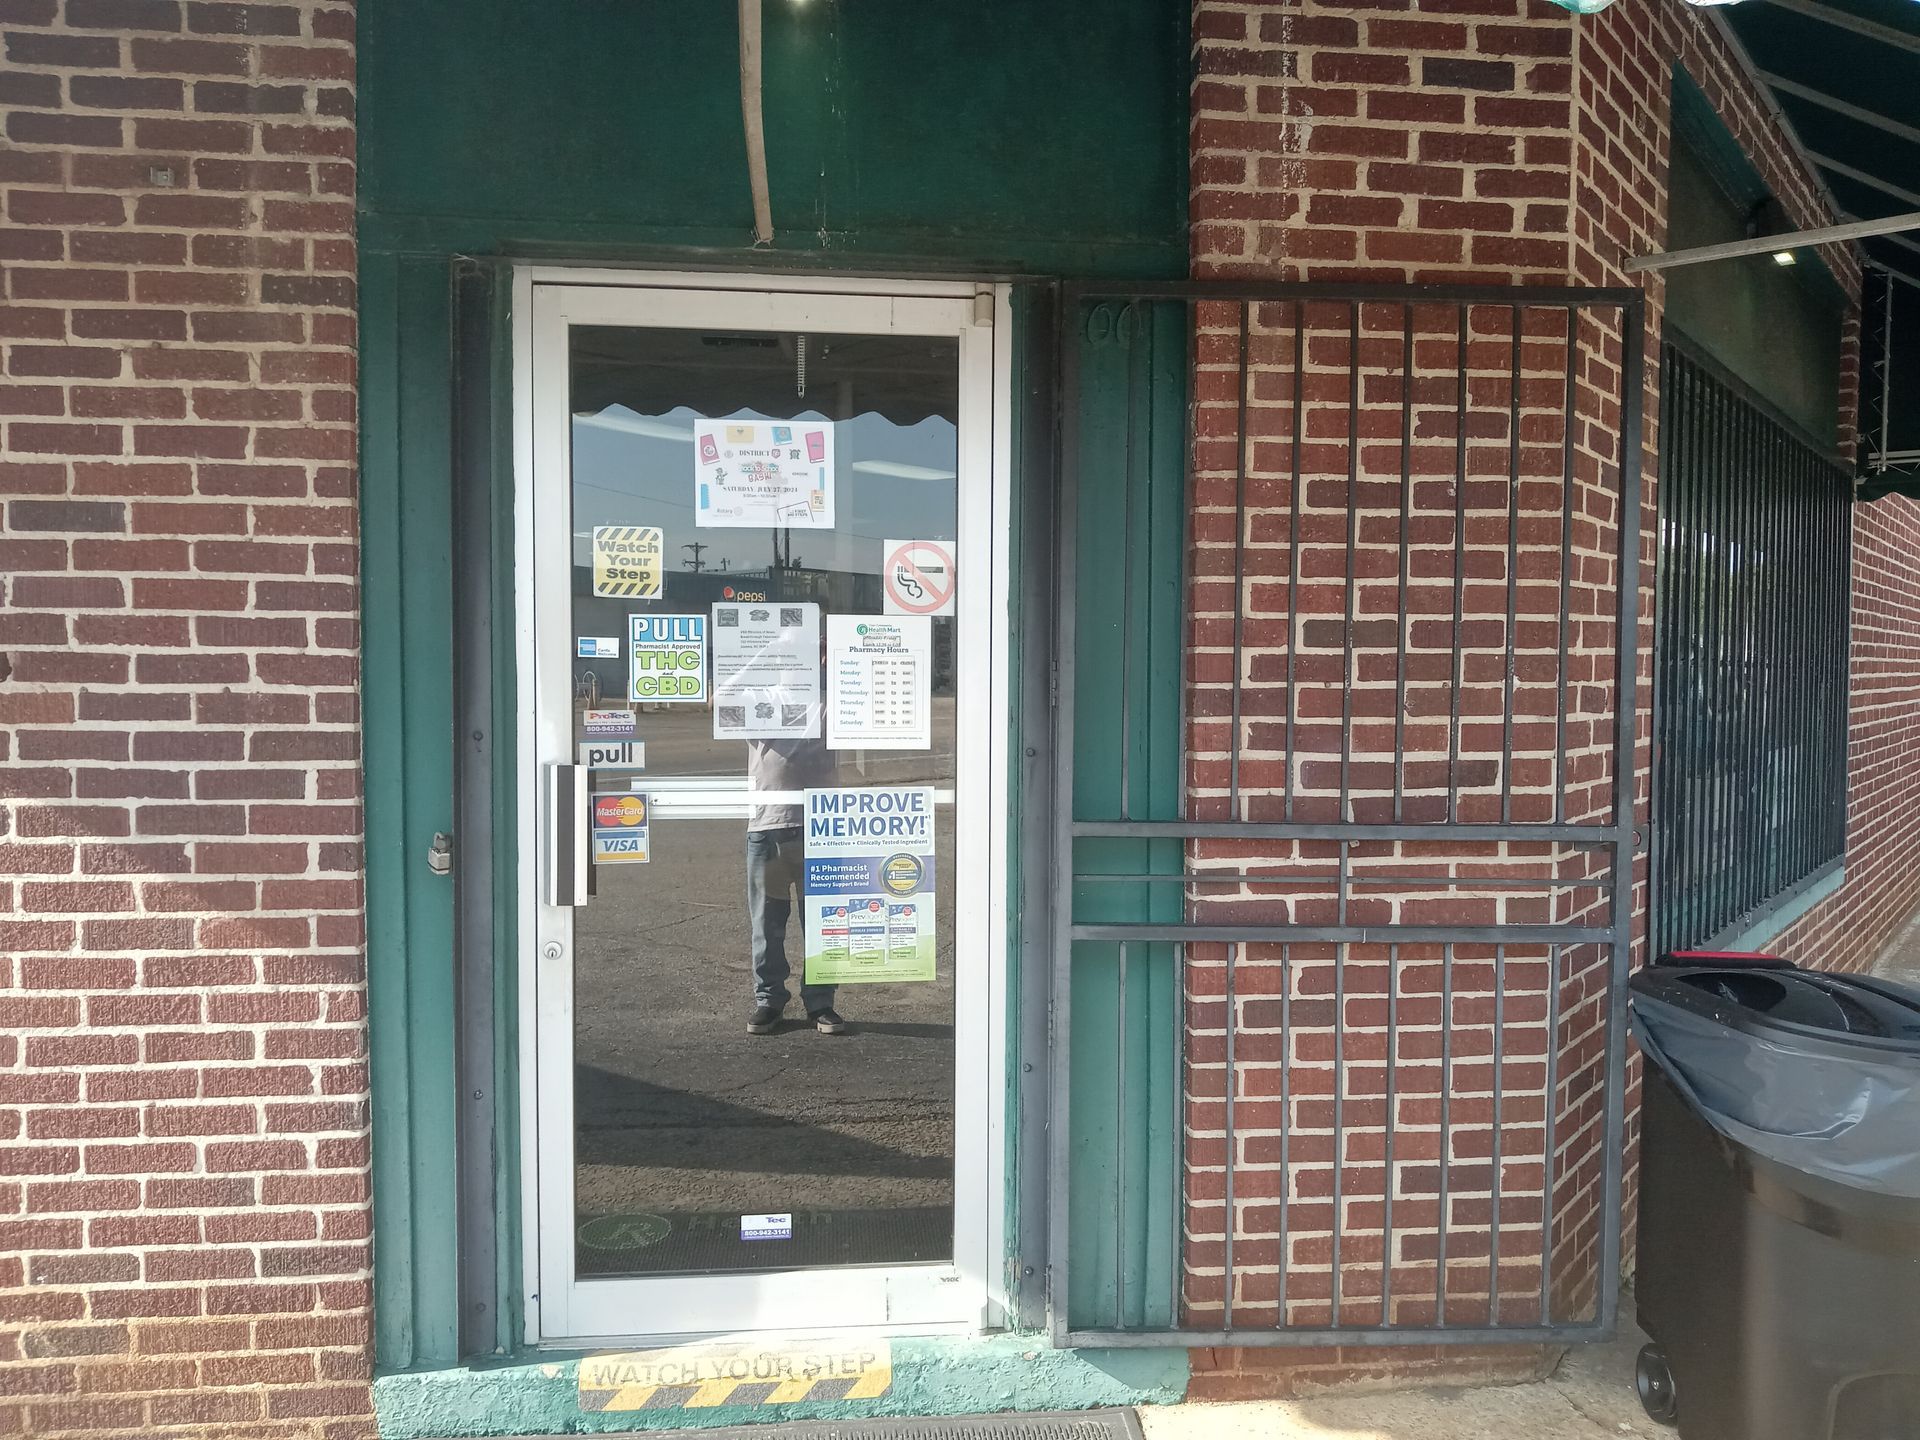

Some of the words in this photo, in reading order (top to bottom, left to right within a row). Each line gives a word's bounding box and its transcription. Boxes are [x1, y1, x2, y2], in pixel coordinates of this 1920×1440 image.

[597, 540, 659, 554] Watch
[606, 554, 651, 566] Your
[606, 568, 651, 582] Step
[737, 591, 766, 602] pepsi
[633, 617, 702, 641] PULL
[671, 643, 701, 651] Approved
[849, 646, 885, 654] Pharmacy
[636, 651, 700, 670] THC
[636, 676, 700, 696] CBD
[589, 712, 630, 720] ProTec
[589, 742, 632, 767] pull
[812, 793, 924, 813] IMPROVE
[596, 806, 644, 817] MasterCard
[604, 840, 639, 851] VISA
[810, 865, 820, 873] #1
[822, 864, 867, 872] Pharmacist
[811, 873, 869, 881] Recommended
[593, 1362, 699, 1386] WATCH
[711, 1353, 792, 1380] YOUR
[802, 1352, 876, 1376] STEP
